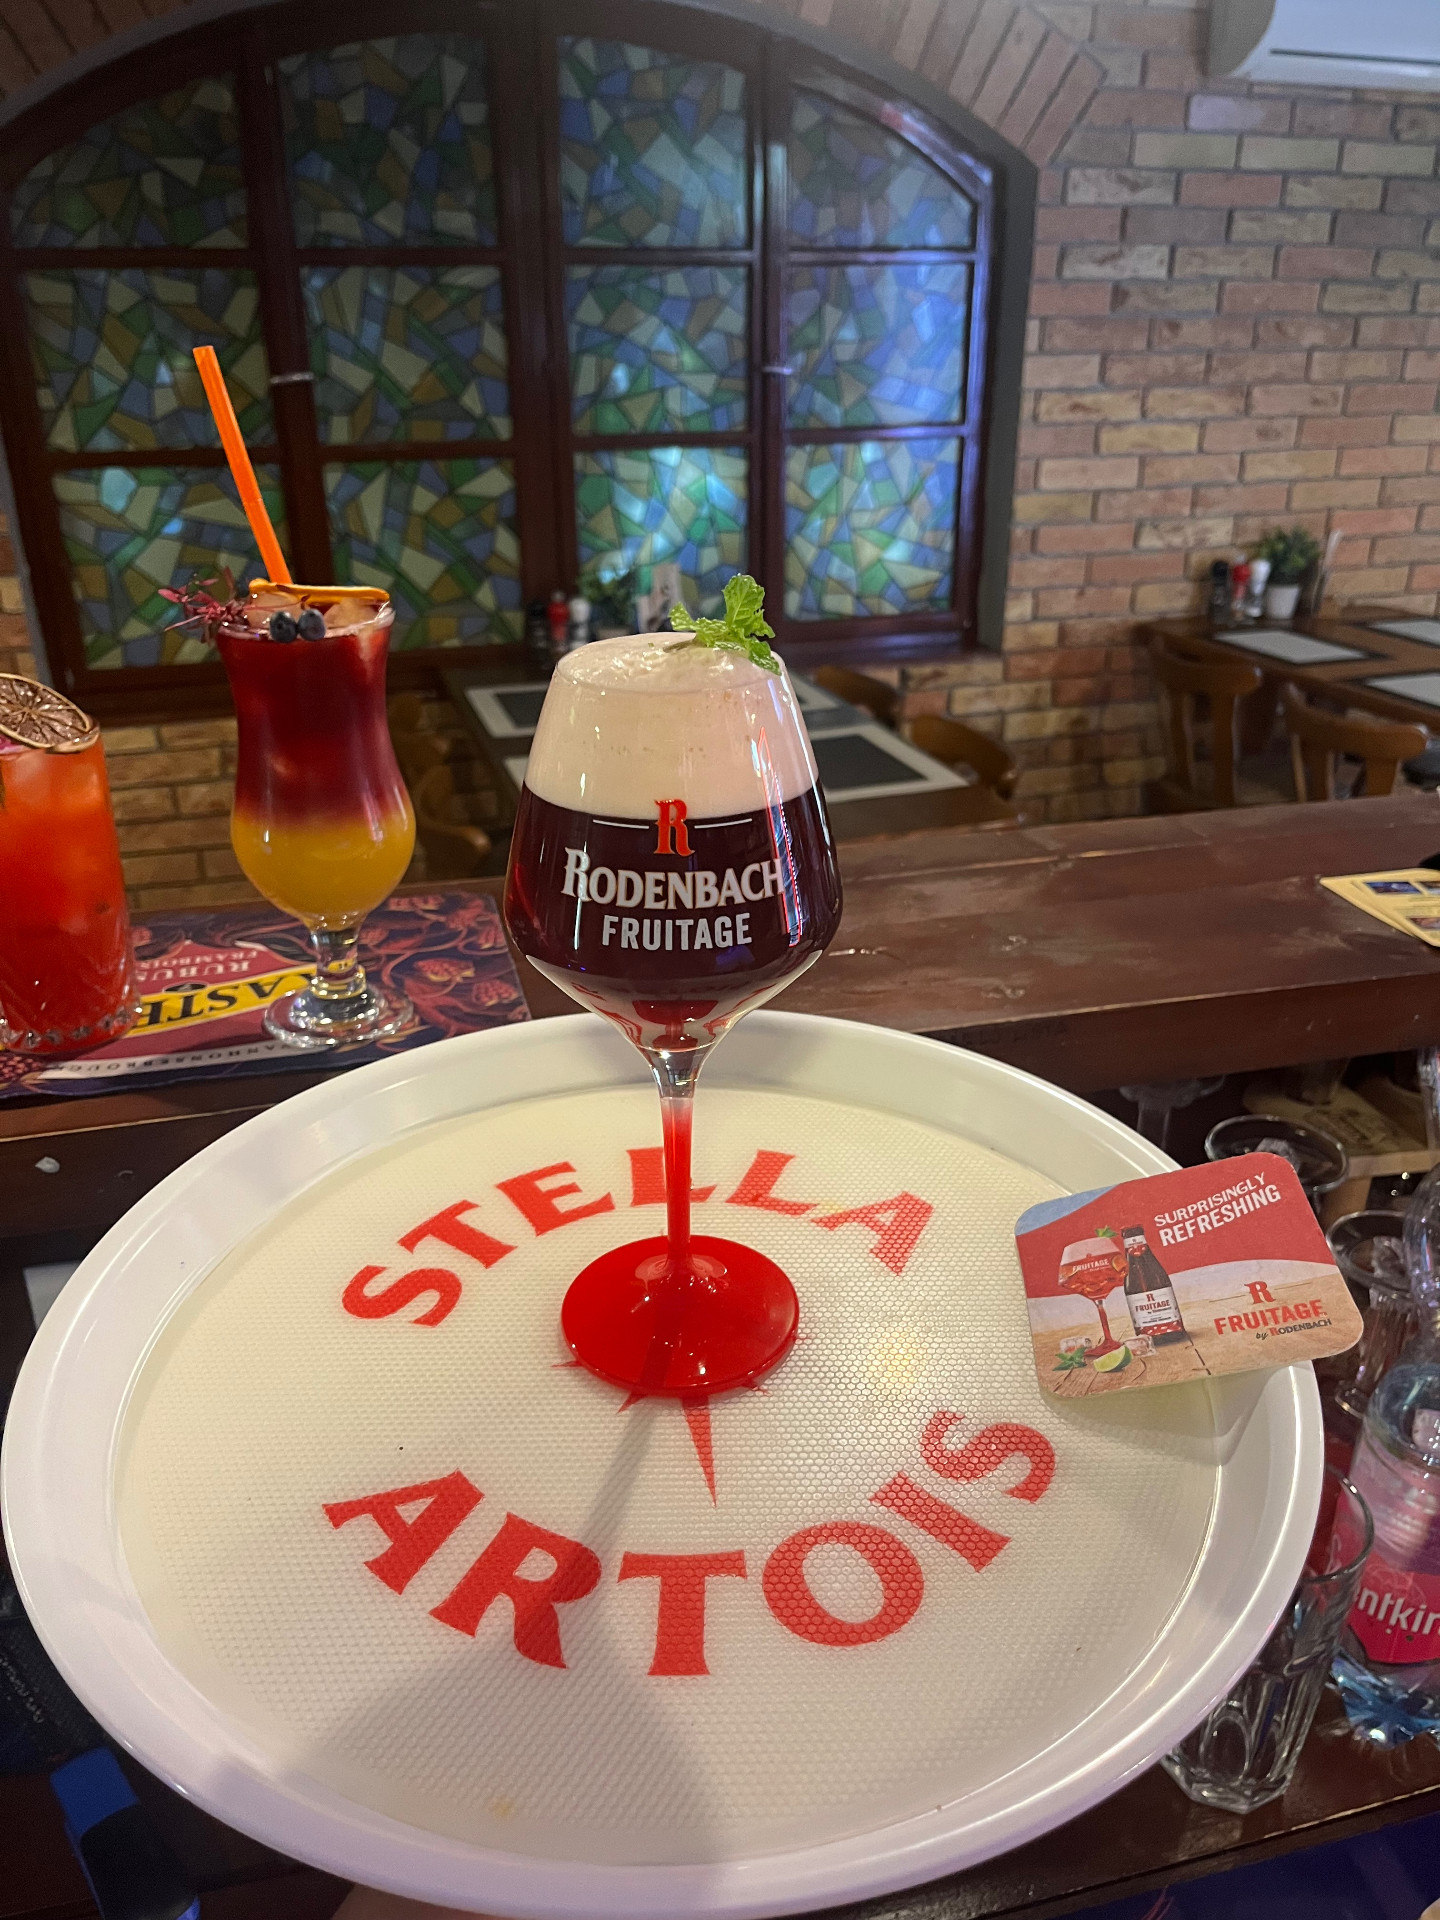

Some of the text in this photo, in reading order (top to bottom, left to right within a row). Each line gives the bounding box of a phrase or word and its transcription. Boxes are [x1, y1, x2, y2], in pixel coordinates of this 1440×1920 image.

[654, 798, 696, 857] R
[560, 847, 786, 910] RODENBACH
[602, 912, 753, 951] FRUITAGE
[1153, 1172, 1267, 1227] SURPRISINGLY
[1158, 1184, 1282, 1247] REFRESHING
[341, 1146, 934, 1328] STELLA
[1135, 1299, 1171, 1313] FRUITAGE
[1213, 1298, 1325, 1336] FRUITAGE
[1243, 1280, 1277, 1305] R
[1269, 1318, 1333, 1337] RODENBACH
[321, 1409, 1057, 1678] ARTOIS
